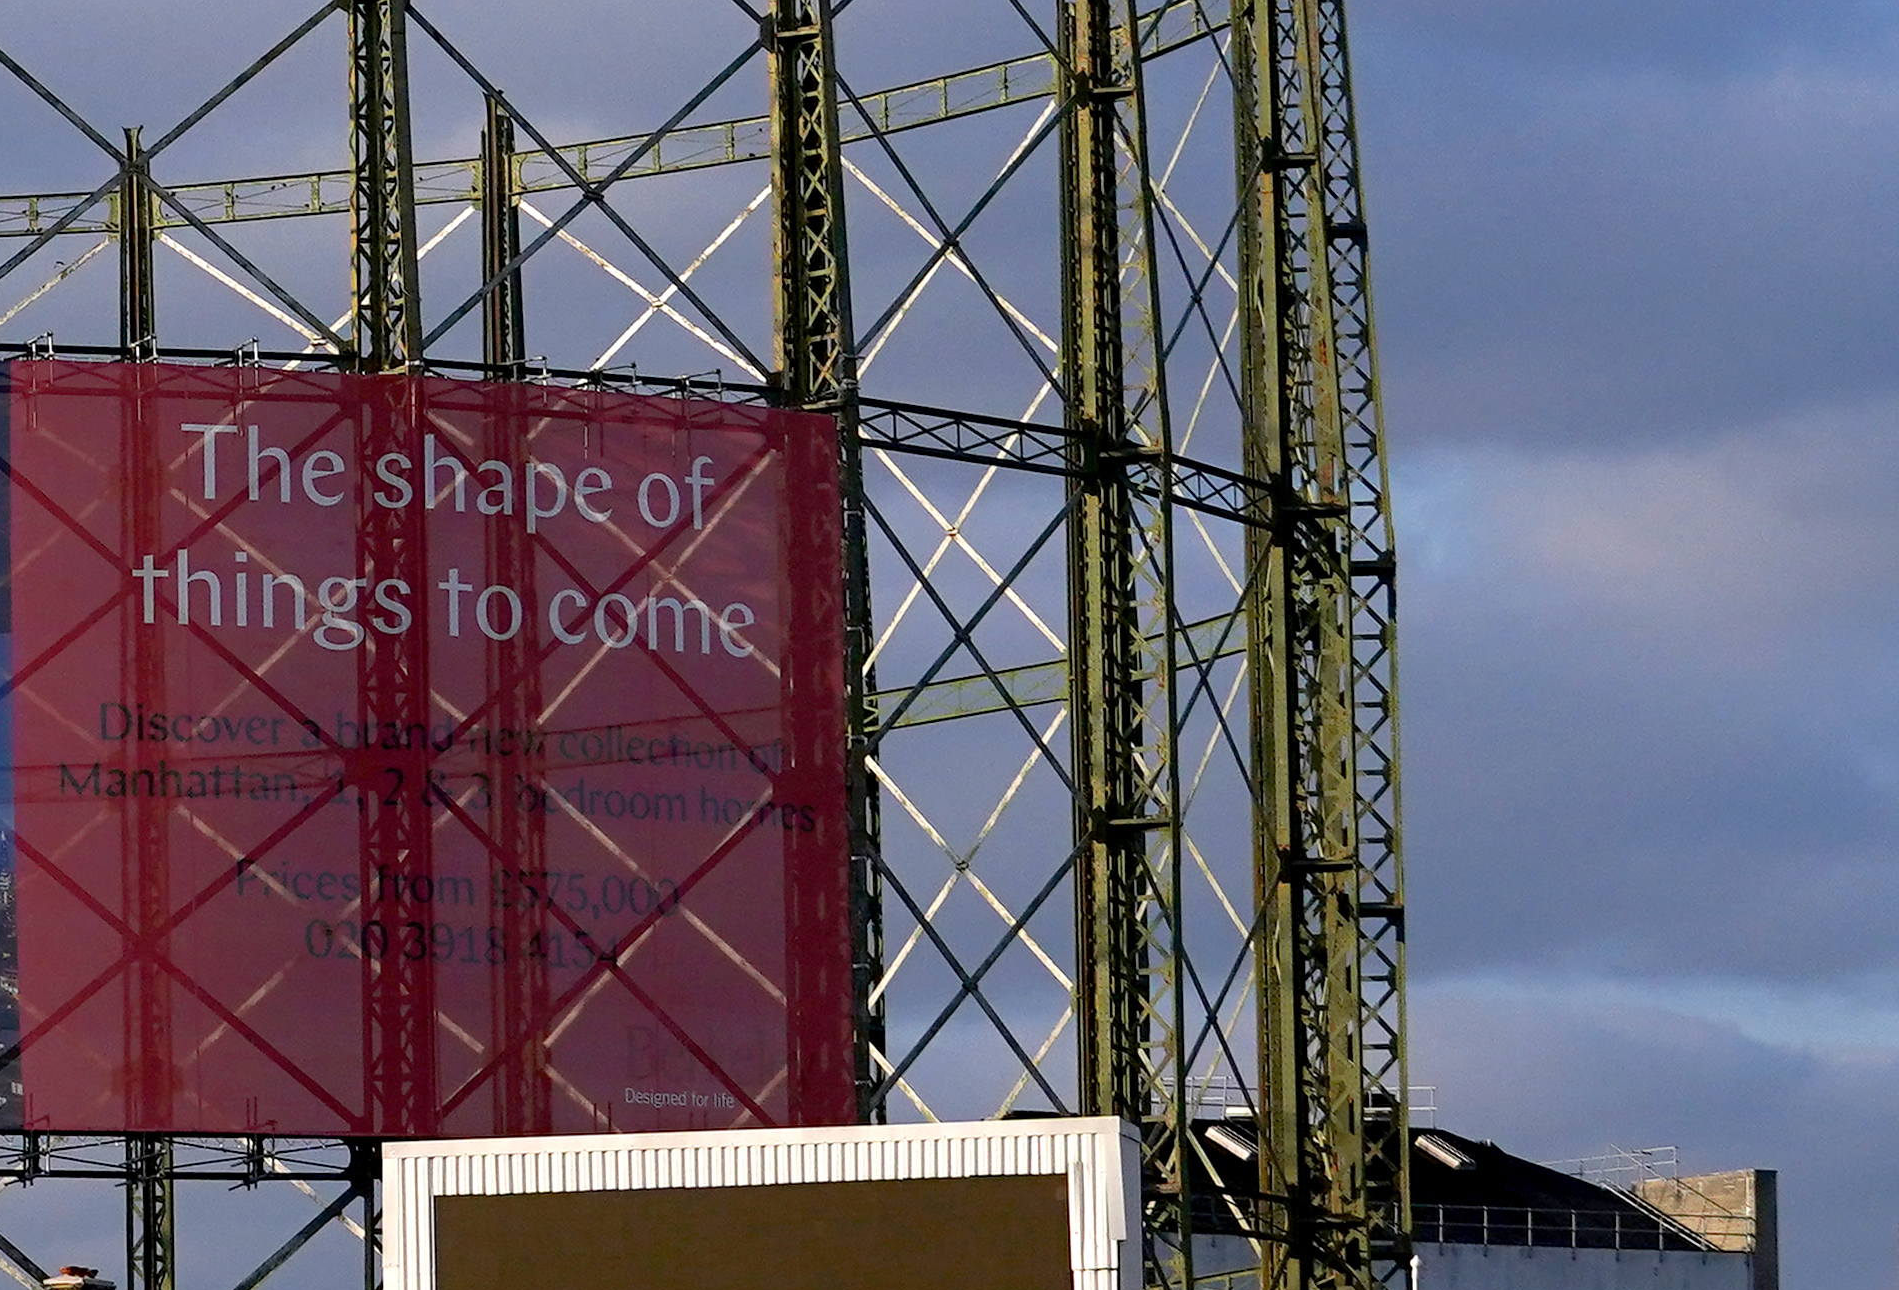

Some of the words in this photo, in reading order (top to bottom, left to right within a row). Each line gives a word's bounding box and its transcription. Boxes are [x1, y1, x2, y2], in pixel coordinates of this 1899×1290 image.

[181, 422, 346, 508] The
[372, 433, 613, 535] shape
[636, 455, 715, 531] of
[132, 547, 413, 652] things
[437, 566, 523, 642] to
[549, 587, 756, 659] come
[99, 701, 286, 746] Discover
[301, 717, 322, 748] a
[336, 711, 454, 753] brand
[470, 724, 546, 758] new
[559, 723, 738, 771] collection
[748, 736, 791, 775] of
[58, 758, 313, 812] Manhattan,
[382, 766, 407, 808] 2
[470, 771, 493, 810] 3
[515, 772, 688, 823] bedroom
[700, 785, 816, 833] homes
[235, 857, 360, 902] Prices
[376, 861, 476, 906] from
[304, 917, 391, 962] 020
[403, 920, 511, 968] 3918
[625, 1087, 687, 1109] Designed
[691, 1091, 709, 1108] for
[713, 1091, 735, 1109] life
